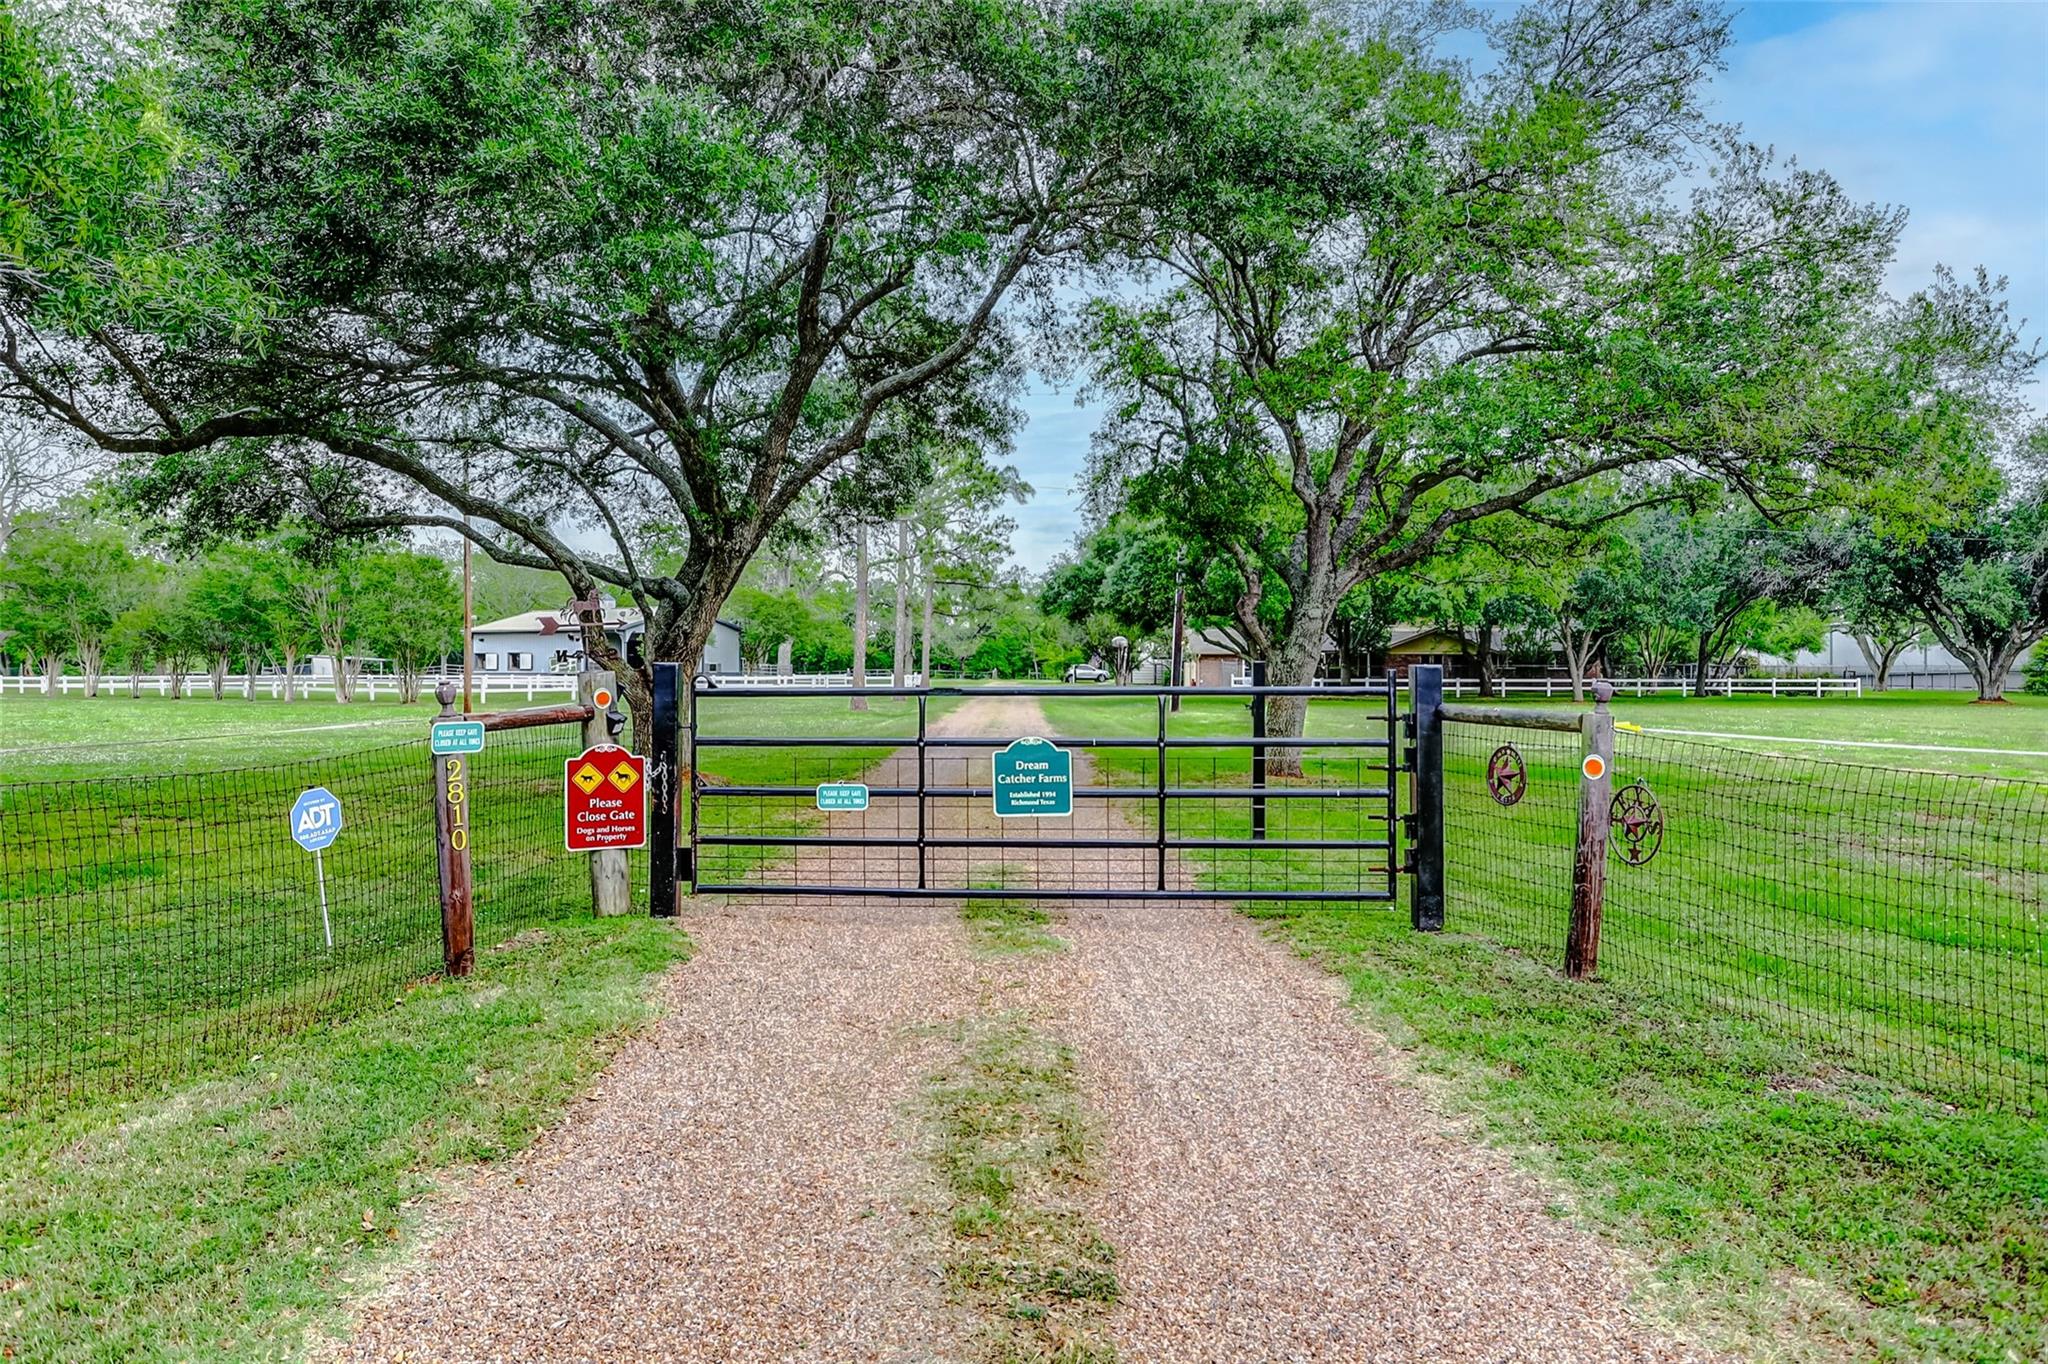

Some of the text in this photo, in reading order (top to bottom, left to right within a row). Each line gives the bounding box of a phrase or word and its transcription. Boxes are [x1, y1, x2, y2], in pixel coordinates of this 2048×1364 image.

[1015, 761, 1049, 770] Dream
[997, 774, 1068, 784] Catcher Farms
[447, 760, 467, 851] 2810
[589, 797, 623, 808] Please
[298, 802, 336, 834] ADT
[577, 810, 635, 822] Close Gate
[576, 826, 595, 835] Dogs
[596, 825, 610, 833] and
[596, 833, 627, 842] Property
